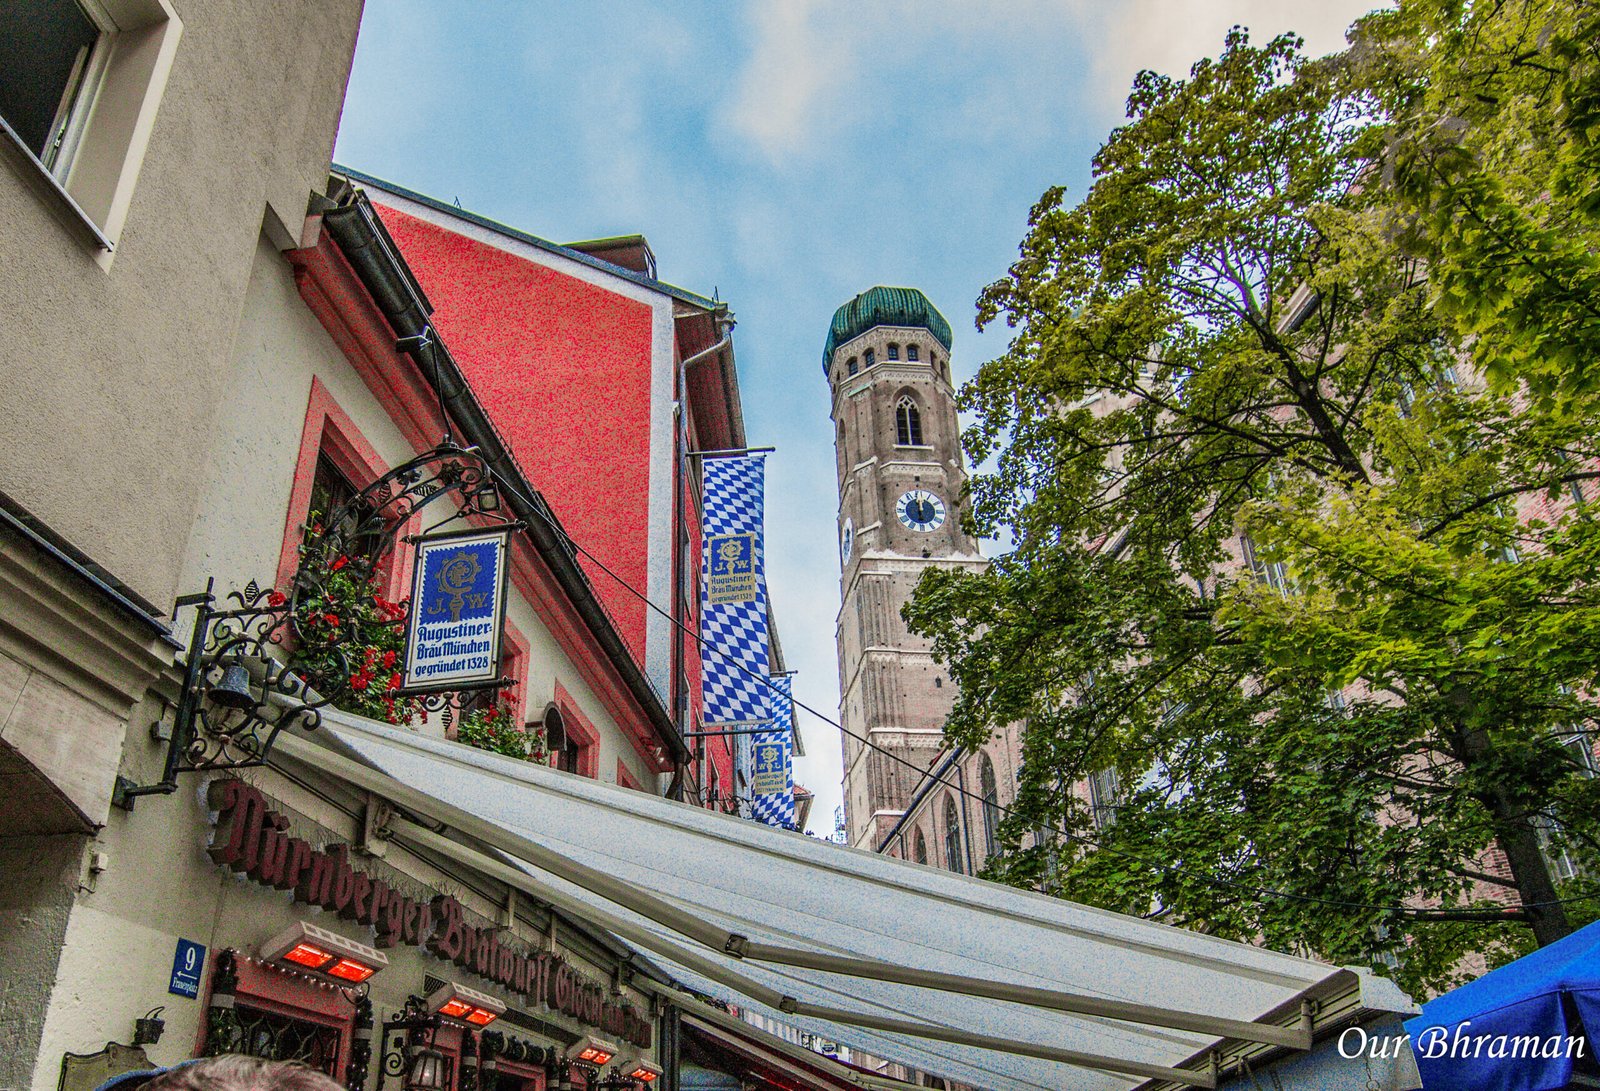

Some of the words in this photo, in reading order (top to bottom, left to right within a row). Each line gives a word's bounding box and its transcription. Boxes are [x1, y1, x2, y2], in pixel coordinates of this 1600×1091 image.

[416, 642, 441, 660] Bräu
[441, 639, 491, 656] München
[415, 660, 466, 677] gegründet
[467, 656, 488, 670] 1328
[185, 947, 196, 971] 9
